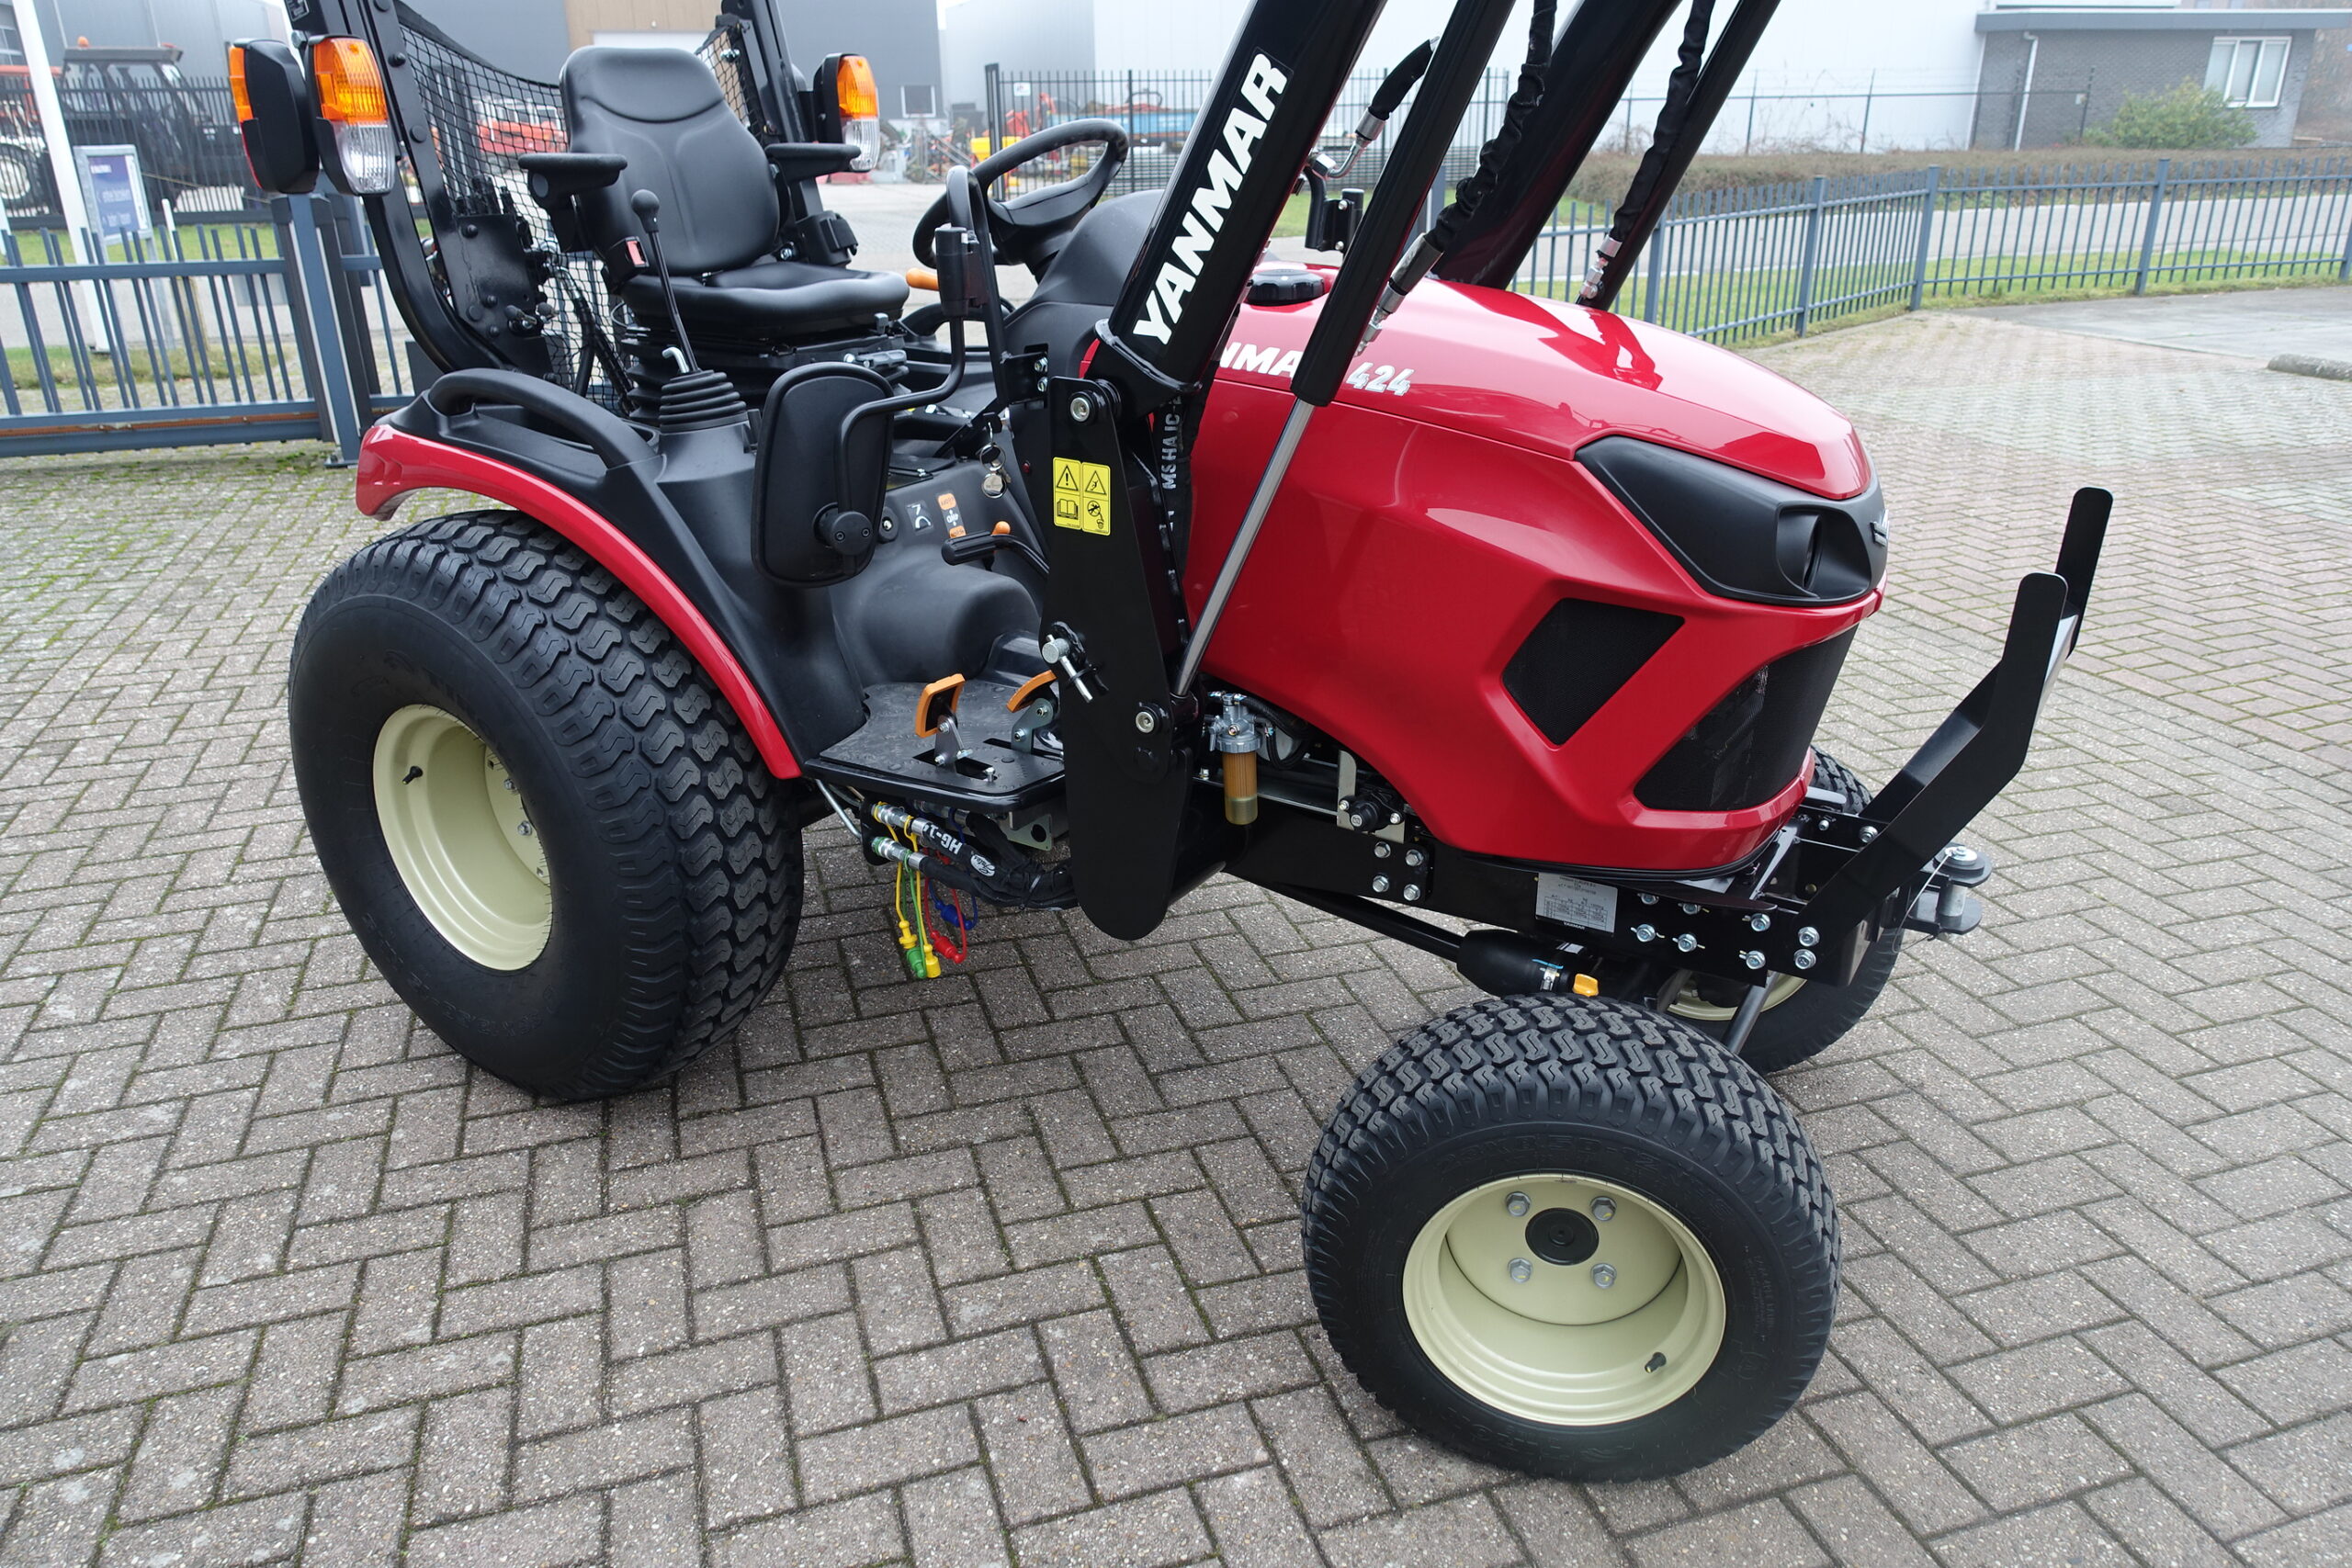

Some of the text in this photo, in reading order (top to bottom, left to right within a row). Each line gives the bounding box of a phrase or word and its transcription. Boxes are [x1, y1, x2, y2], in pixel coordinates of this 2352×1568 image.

[1132, 53, 1287, 344] YANMAR
[1219, 342, 1415, 396] NMA 424
